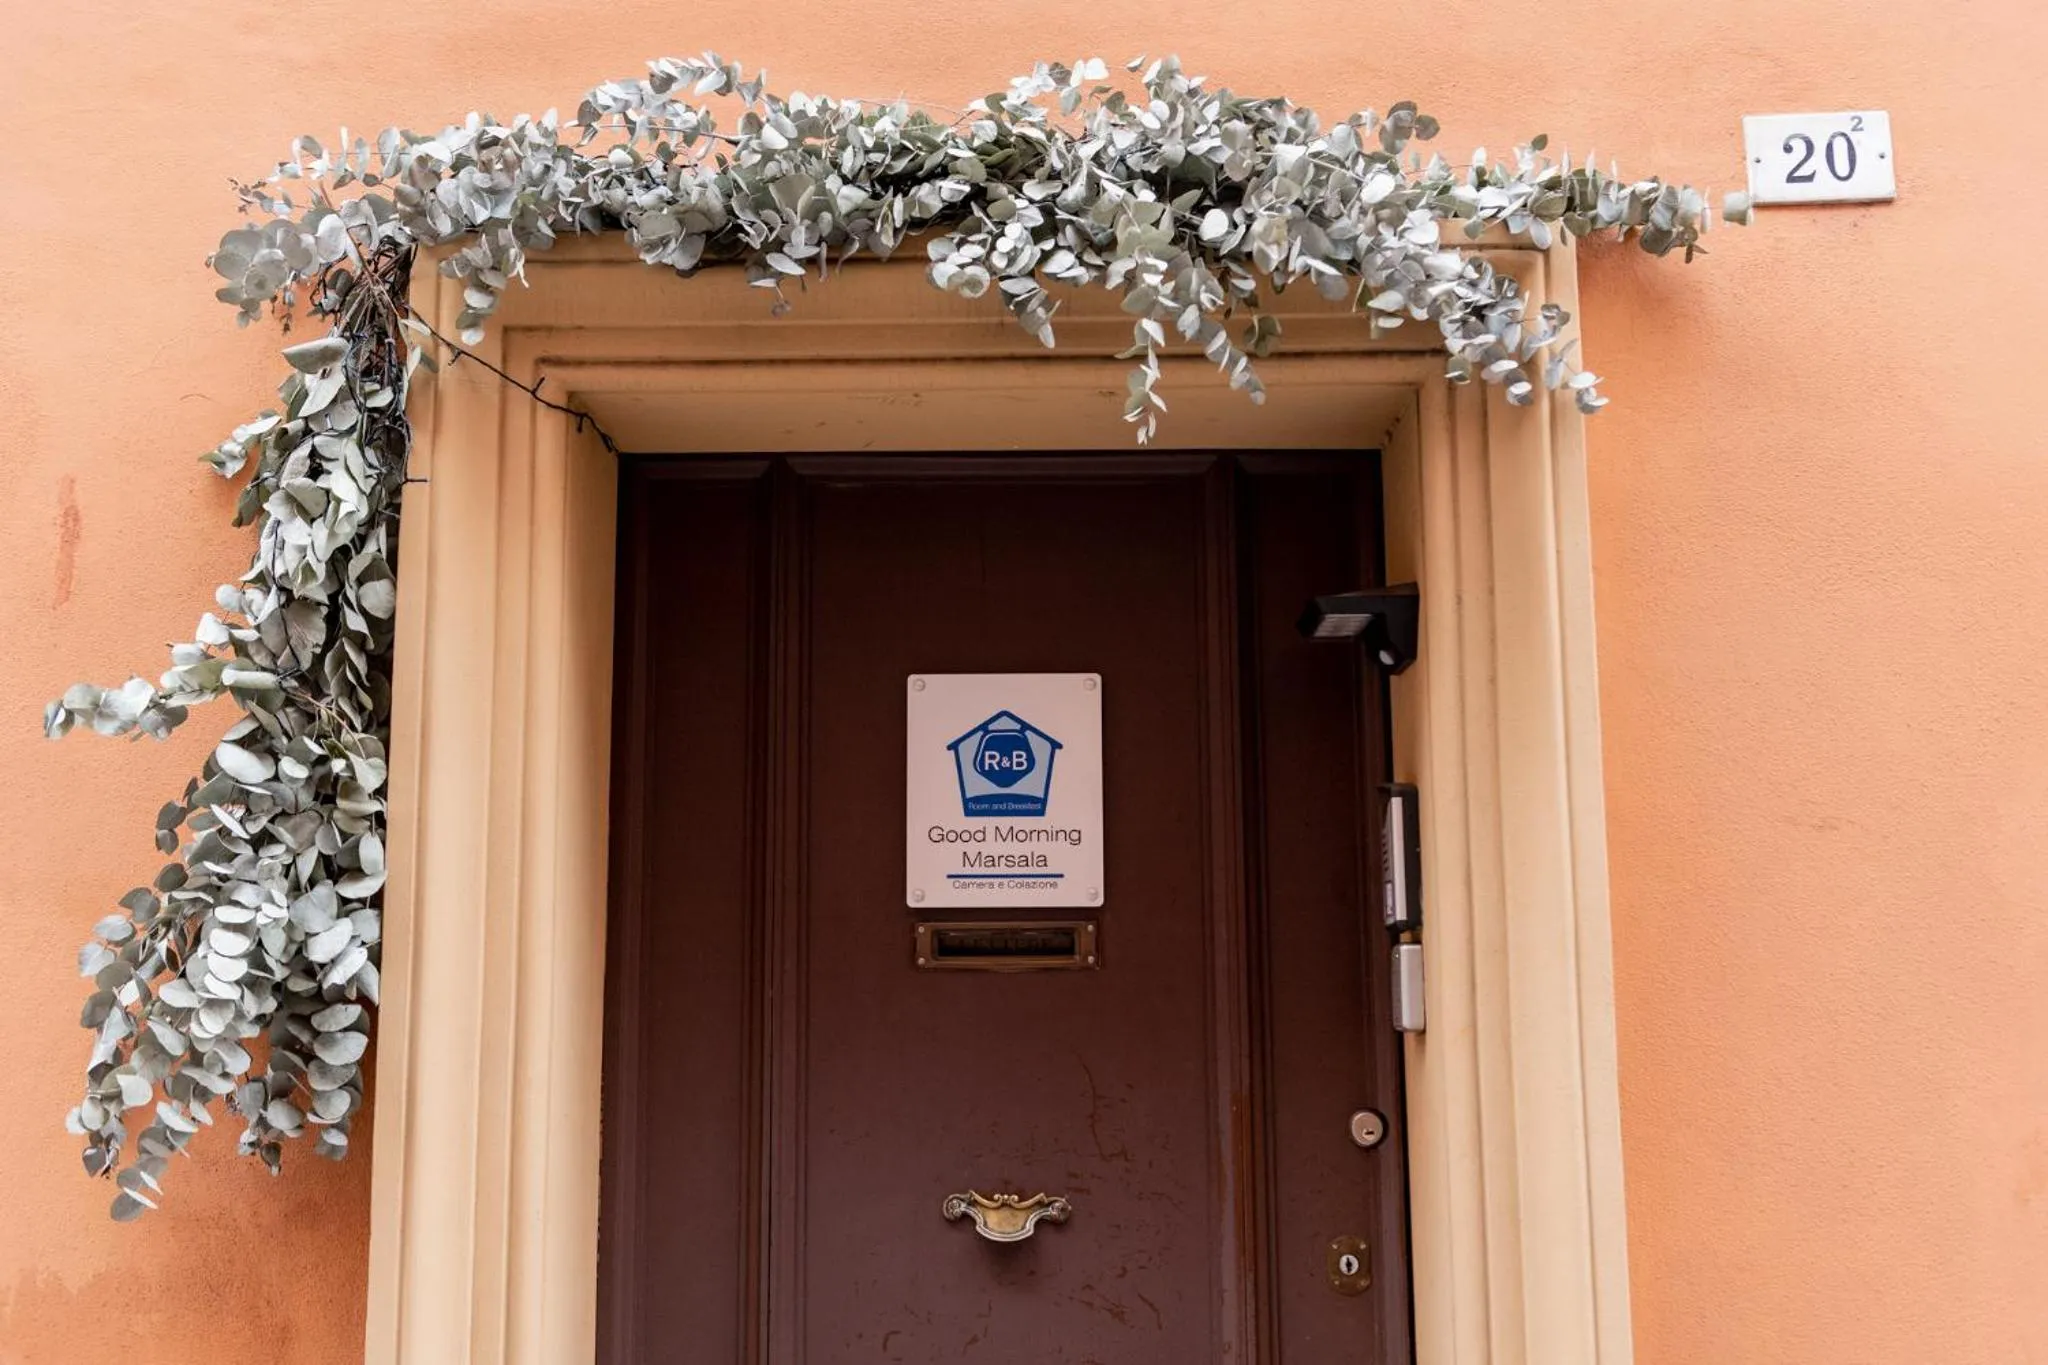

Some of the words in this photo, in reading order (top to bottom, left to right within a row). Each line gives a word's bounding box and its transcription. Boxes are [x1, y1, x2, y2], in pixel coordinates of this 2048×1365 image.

[984, 750, 1028, 771] R&B
[928, 825, 987, 843] Good
[994, 825, 1082, 846] Morning
[962, 851, 1048, 868] Marsala
[952, 880, 995, 890] Camera
[997, 881, 1005, 890] e
[1007, 880, 1059, 890] Colazione
